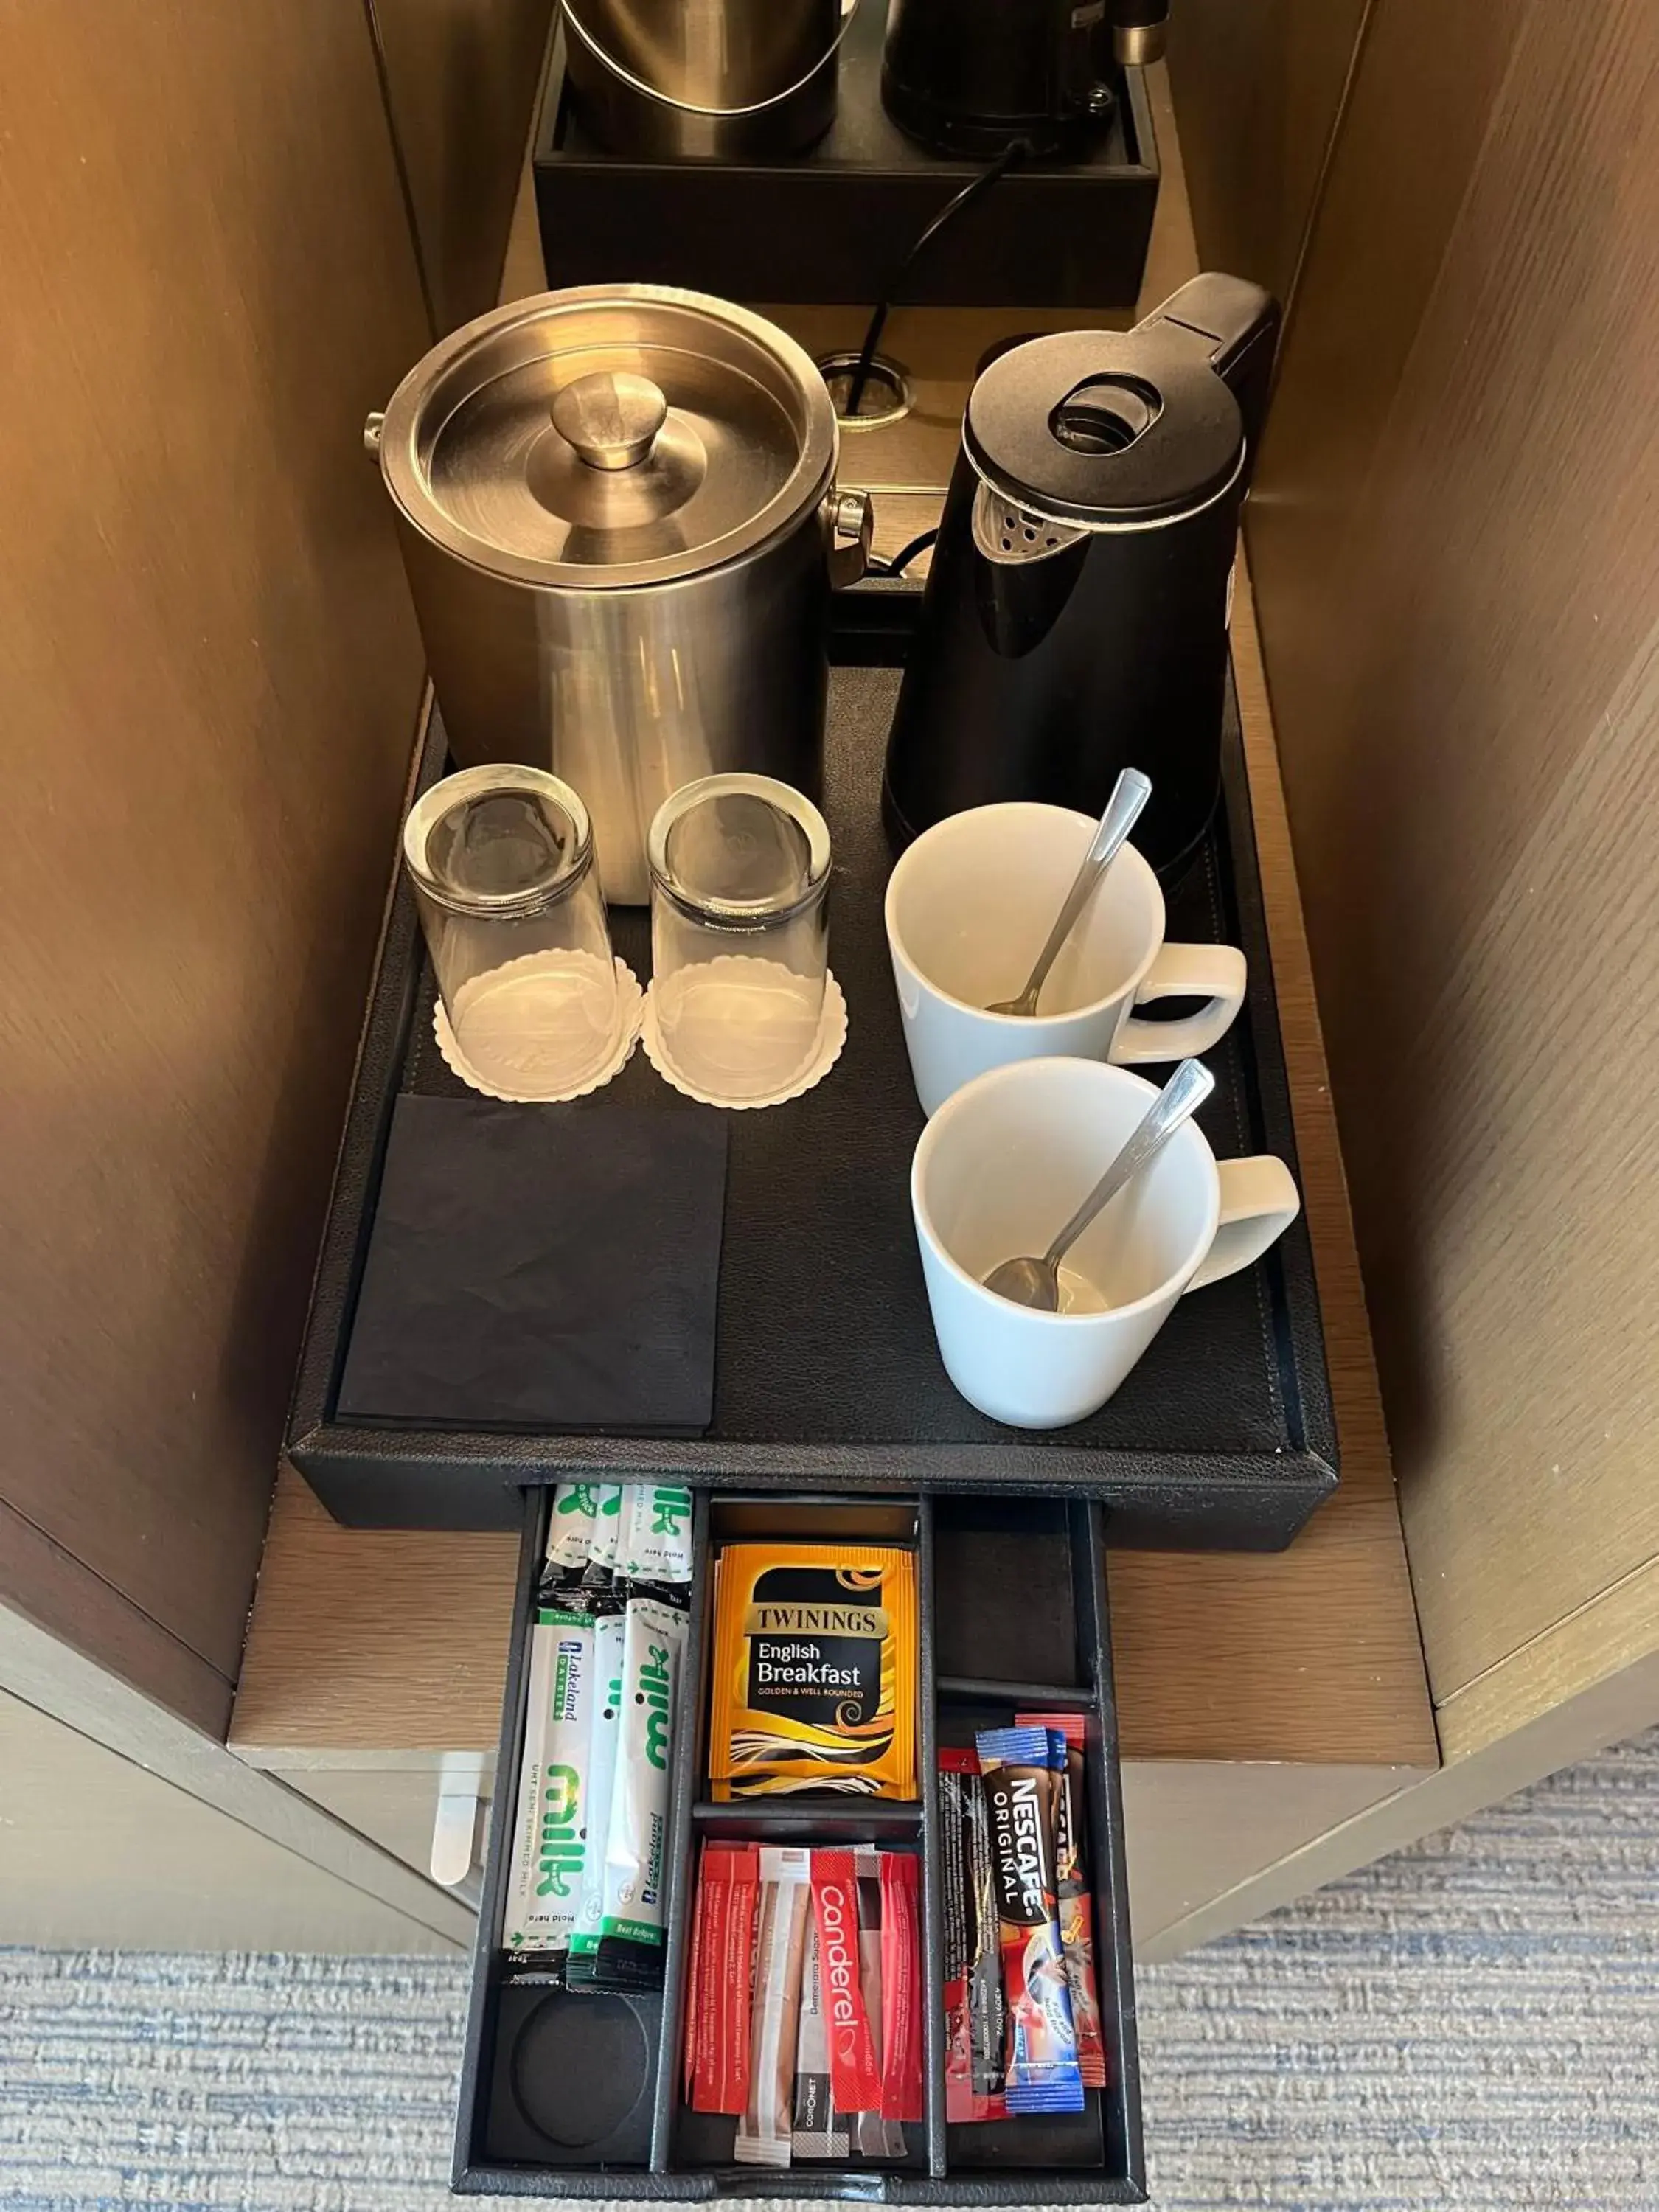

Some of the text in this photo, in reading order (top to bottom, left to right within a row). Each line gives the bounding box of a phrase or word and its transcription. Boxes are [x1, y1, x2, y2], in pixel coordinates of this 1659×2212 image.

[758, 1608, 876, 1632] TWININGS
[757, 1662, 861, 1686] Breakfast
[759, 1642, 821, 1663] English
[565, 1655, 582, 1722] Lakeland
[635, 1644, 669, 1770] milk
[757, 1687, 864, 1699] GOLDEN & WELL ROUNDED
[536, 1764, 586, 1896] milk
[994, 1792, 1019, 1905] ORIGINAL
[552, 1914, 574, 1922] Hold
[821, 1885, 858, 2026] Canderel
[805, 2077, 817, 2127] CORONET
